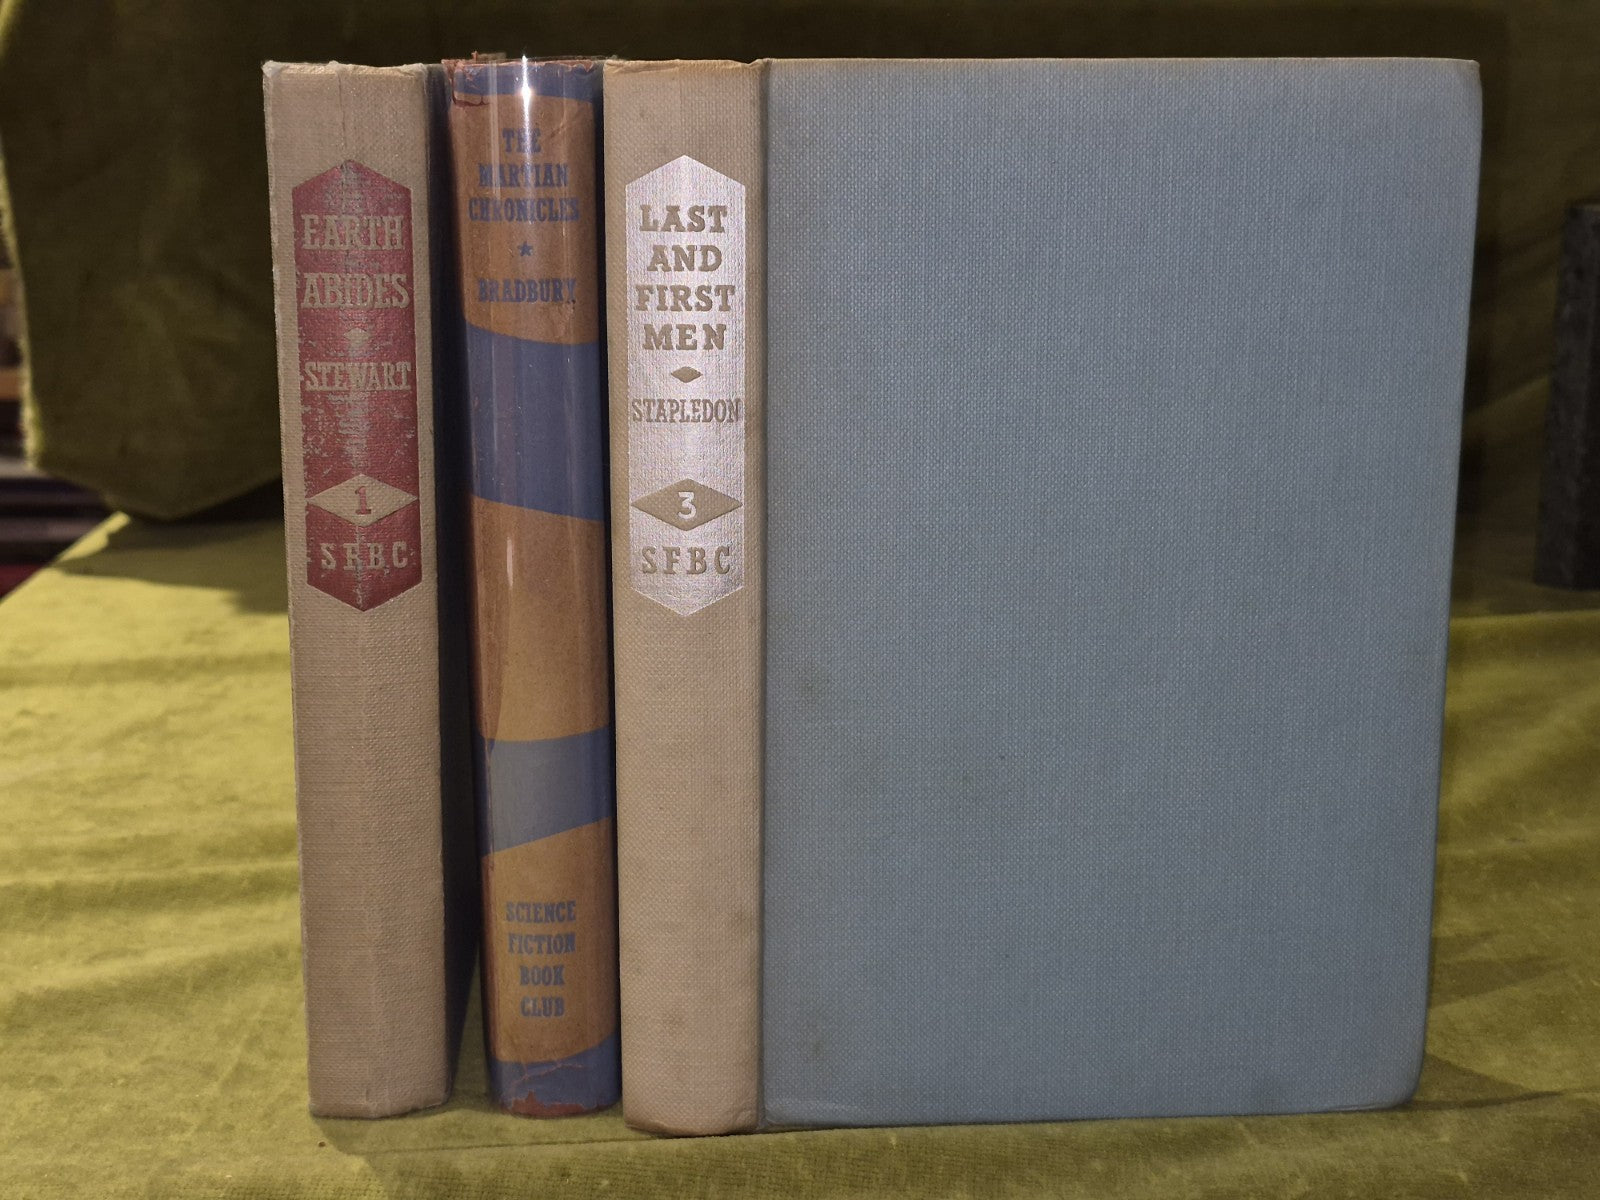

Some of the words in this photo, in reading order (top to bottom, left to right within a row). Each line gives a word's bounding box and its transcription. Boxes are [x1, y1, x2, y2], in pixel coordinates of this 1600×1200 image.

[502, 127, 541, 153] THE
[478, 163, 568, 188] MARTIAN
[468, 197, 580, 222] CHRONICLES
[640, 205, 728, 233] LAST
[300, 215, 406, 251] EARTH
[647, 244, 723, 272] AND
[300, 272, 409, 309] ABIDES
[478, 277, 577, 303] BRADBURY
[634, 284, 736, 312] FIRST
[643, 323, 727, 351] MEN
[304, 361, 412, 392] STEWART
[631, 398, 744, 424] STAPLEDON
[354, 485, 372, 516] 1
[677, 491, 697, 520] 3
[506, 900, 577, 923] SCIENCE
[508, 932, 577, 954] FICTION
[520, 964, 565, 986] BOOK
[521, 996, 564, 1017] CLUB
